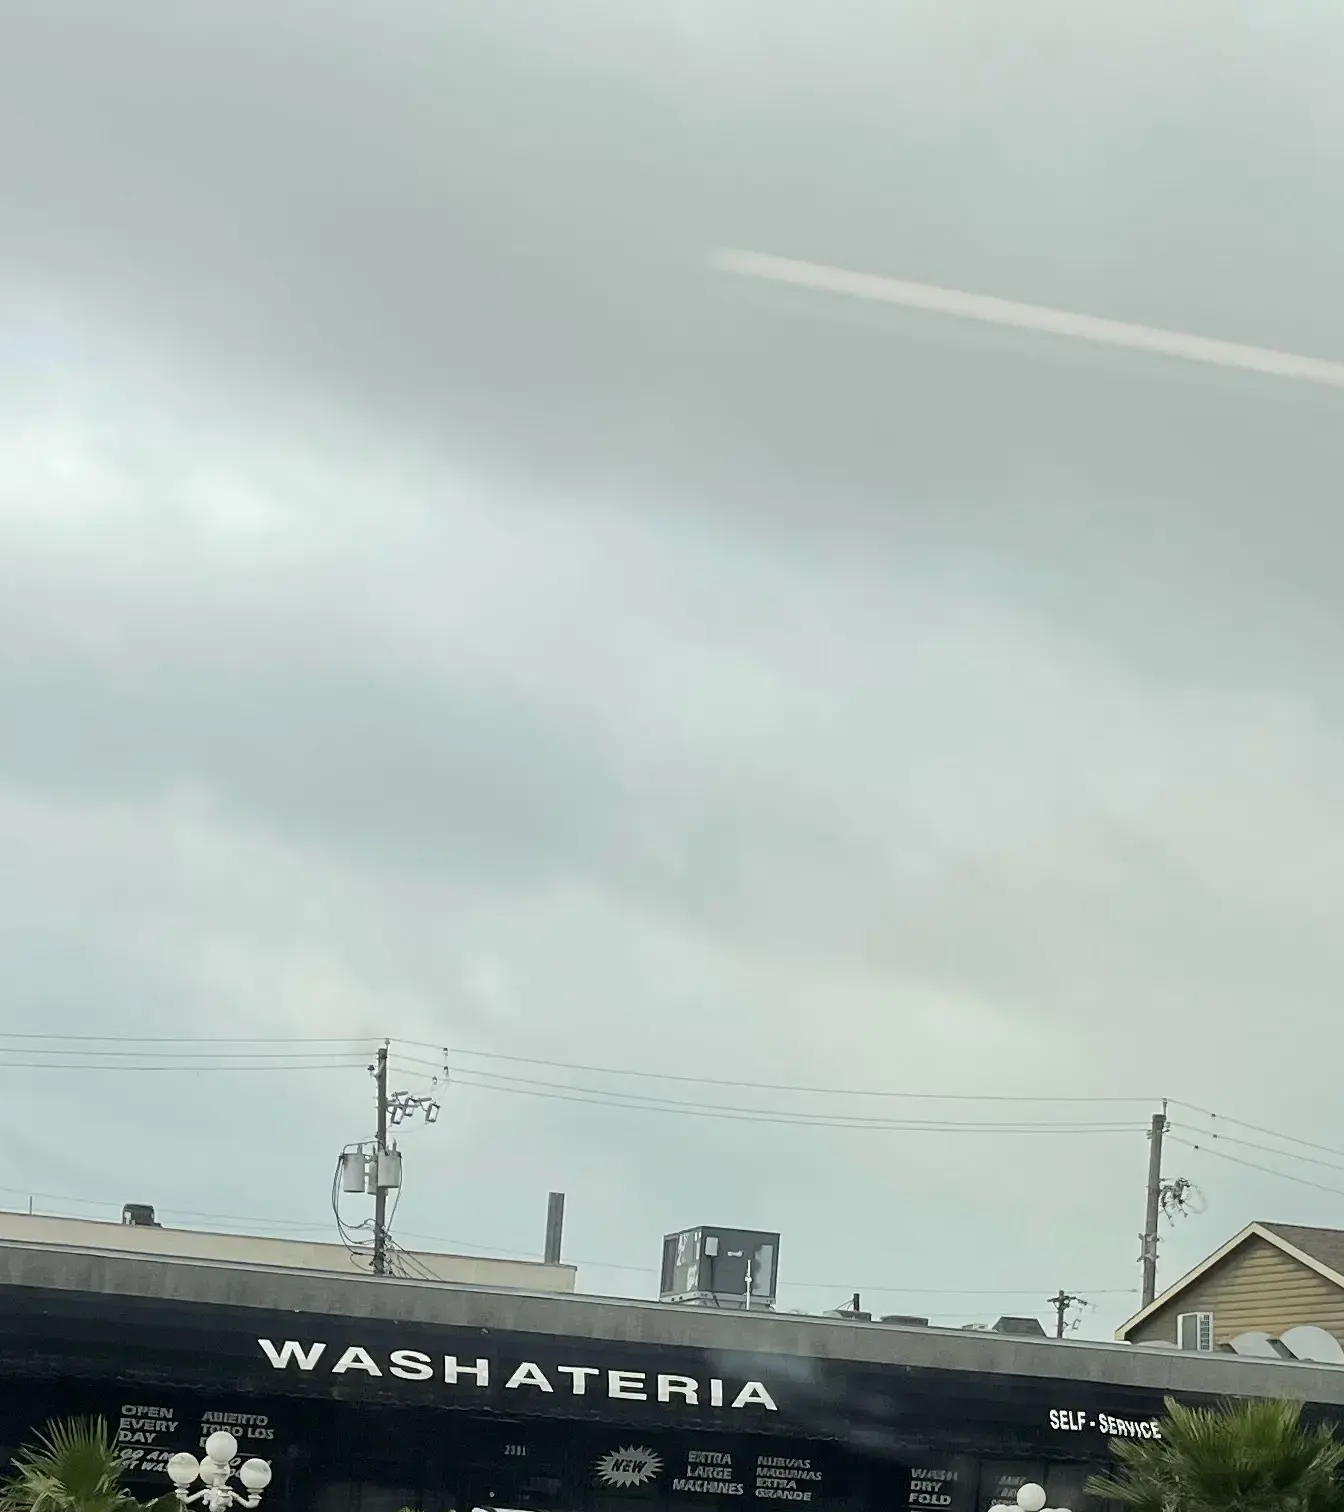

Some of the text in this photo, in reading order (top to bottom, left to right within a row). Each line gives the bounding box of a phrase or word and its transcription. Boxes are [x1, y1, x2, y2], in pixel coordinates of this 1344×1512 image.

[258, 1338, 778, 1411] WASHATERIA
[121, 1404, 174, 1419] OPEN
[201, 1411, 269, 1426] ABIERTO
[120, 1417, 179, 1432] EVERY
[119, 1431, 157, 1444] DAY
[247, 1427, 275, 1440] LOS
[688, 1450, 732, 1465] EXTRA
[757, 1455, 811, 1469] NUEVAS
[611, 1458, 647, 1474] NEW
[687, 1465, 733, 1480] LARGE
[672, 1478, 744, 1496] MACHINES
[756, 1477, 797, 1490] EXTRA
[910, 1480, 943, 1492] DRY
[755, 1488, 812, 1502] GRANDE
[909, 1492, 952, 1505] FOLD
